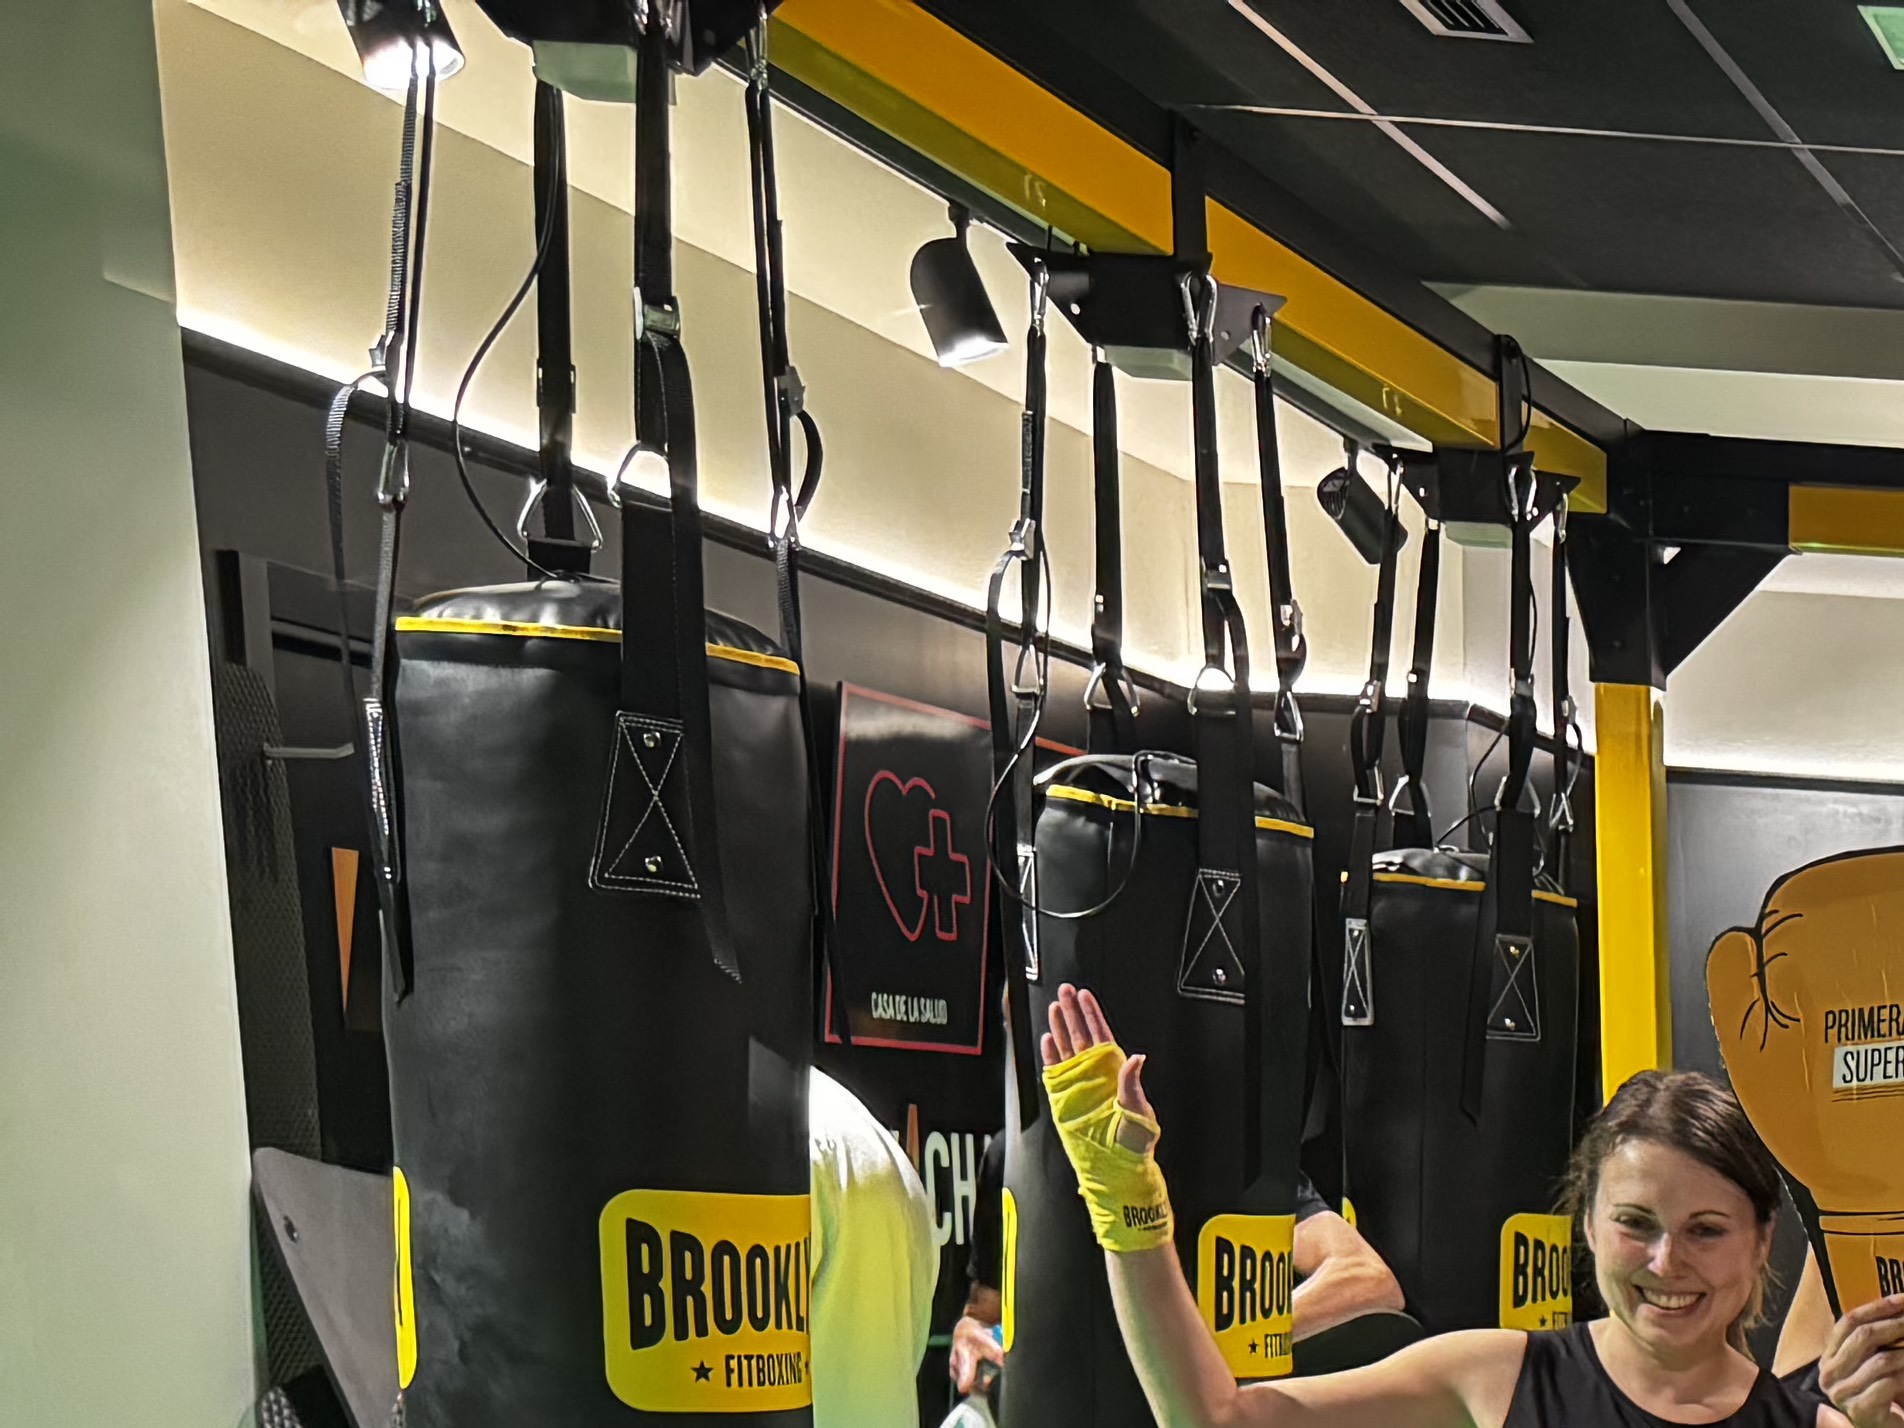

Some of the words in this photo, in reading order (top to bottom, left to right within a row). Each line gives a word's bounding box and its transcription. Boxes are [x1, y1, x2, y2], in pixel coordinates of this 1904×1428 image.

[871, 992, 895, 1020] CASA
[895, 994, 907, 1022] DE
[908, 997, 920, 1023] LA
[920, 997, 948, 1025] SALUD
